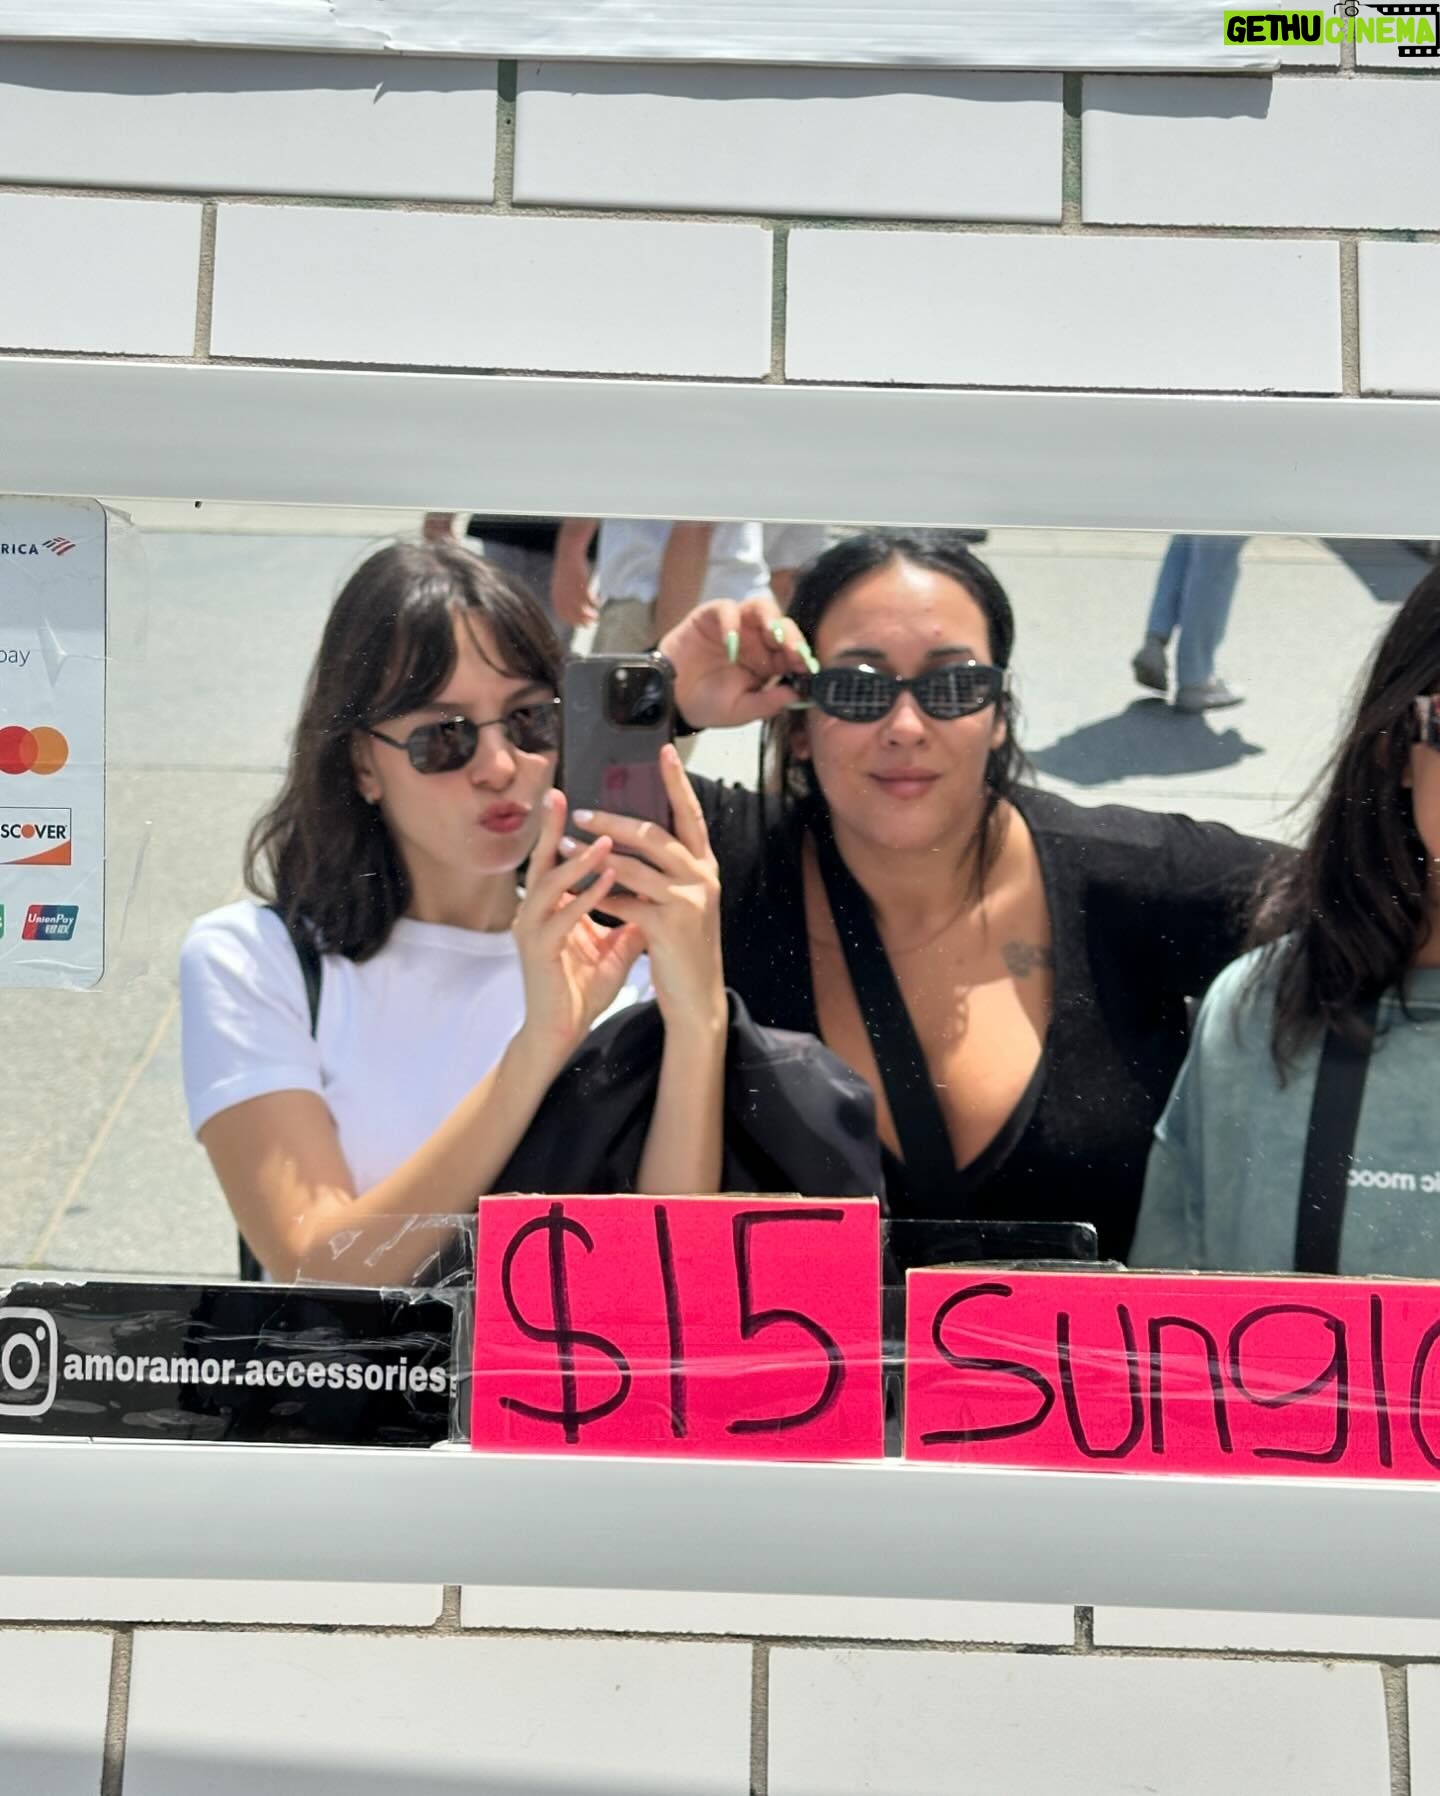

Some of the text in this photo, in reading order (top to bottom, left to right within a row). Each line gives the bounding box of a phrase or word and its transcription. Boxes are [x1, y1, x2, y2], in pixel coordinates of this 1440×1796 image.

[28, 913, 74, 928] UnionPay
[64, 1352, 446, 1393] amoramor.accessories
[501, 1201, 846, 1445] $15
[920, 1282, 1440, 1469] Sungl
